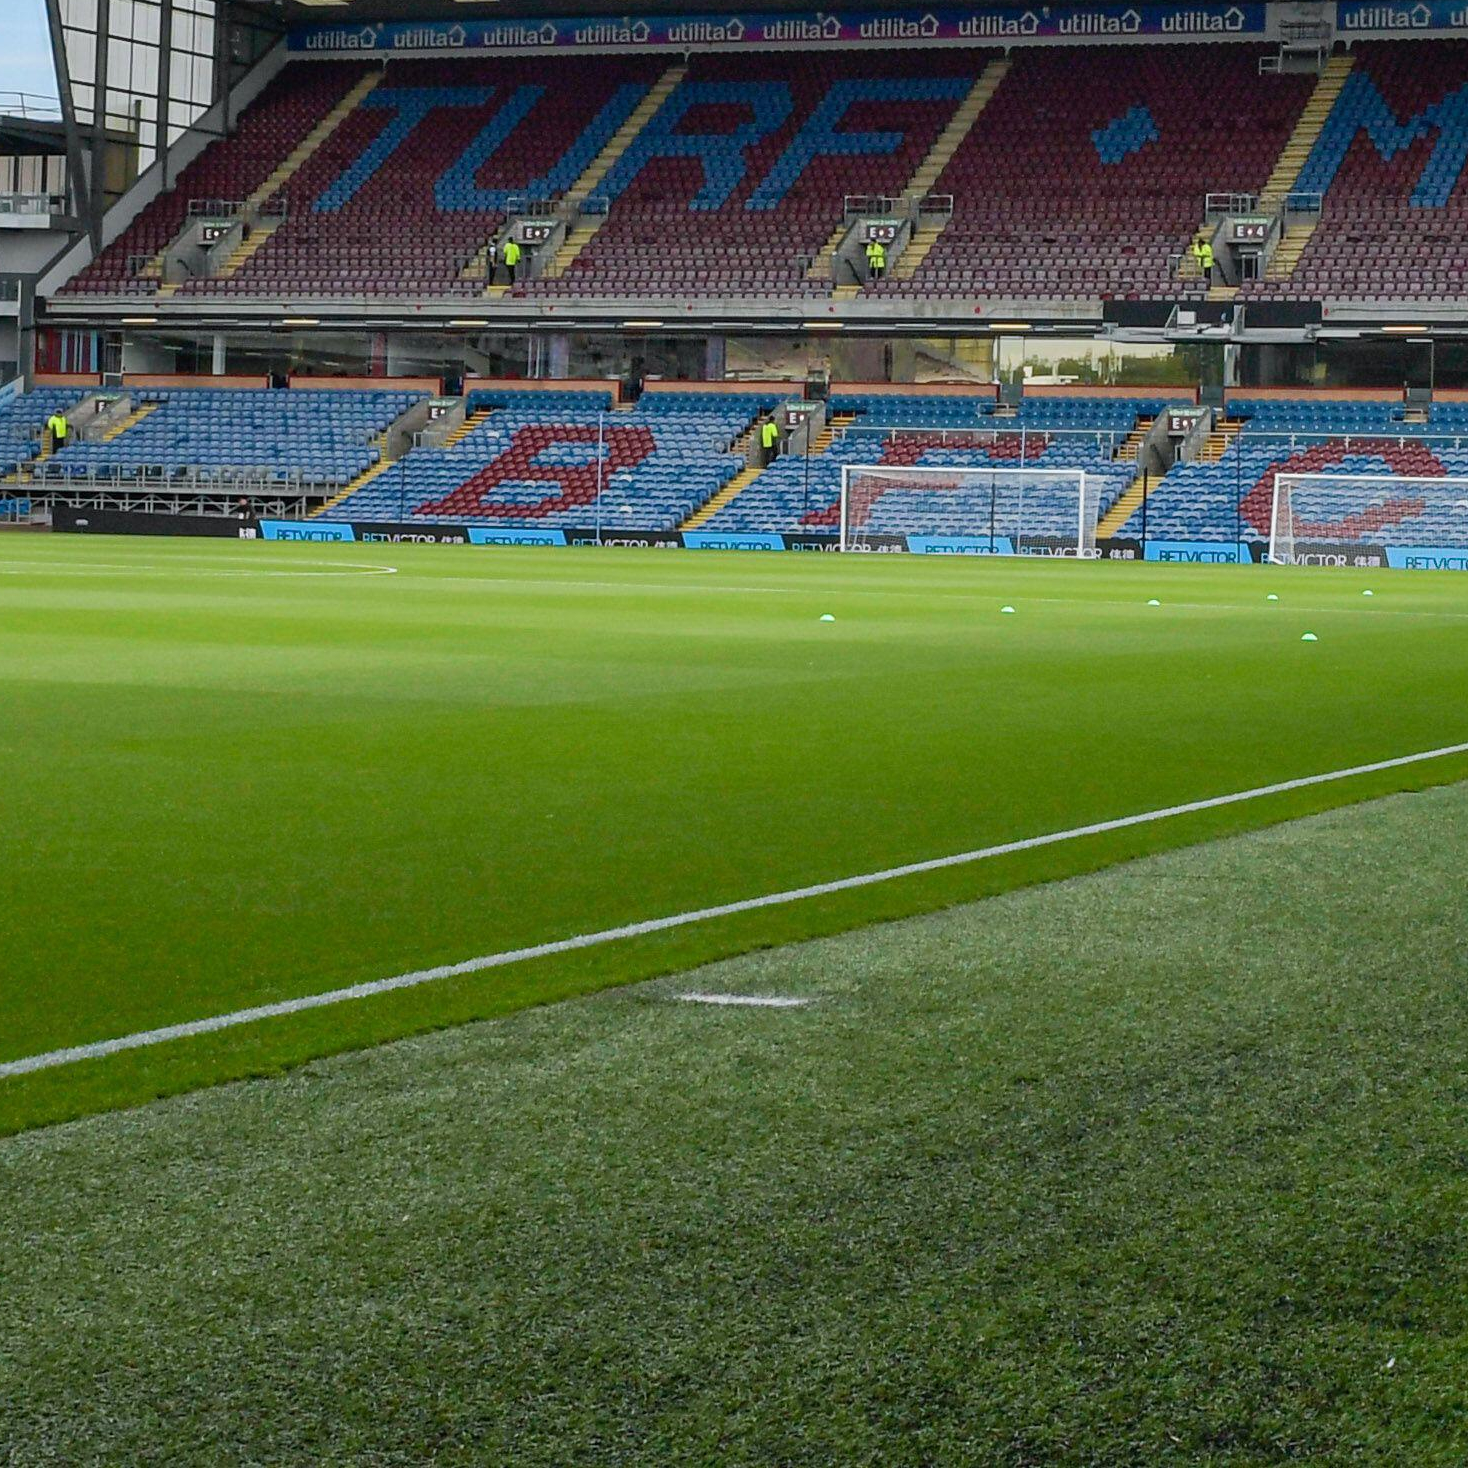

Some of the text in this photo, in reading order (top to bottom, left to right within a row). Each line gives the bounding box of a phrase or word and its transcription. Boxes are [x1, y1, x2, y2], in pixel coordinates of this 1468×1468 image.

[958, 15, 1019, 35] utilita
[1059, 13, 1120, 33] utilita
[1161, 11, 1223, 32] utilita
[1345, 7, 1410, 28] utilita
[484, 26, 538, 47] utilita
[575, 23, 630, 44] utilita
[668, 21, 725, 42] utilita
[763, 20, 821, 39] utilita
[860, 18, 919, 37] utilita
[306, 30, 359, 49] utilita
[393, 28, 447, 48] utilita
[311, 77, 974, 214] TURF
[205, 229, 212, 239] E
[526, 228, 533, 238] E
[869, 227, 895, 238] E 3
[1237, 226, 1264, 237] E 4
[431, 408, 438, 418] E
[789, 413, 796, 424] E
[1172, 418, 1180, 429] E
[792, 543, 871, 552] BETVICOR
[1260, 552, 1347, 566] BTVICTOR
